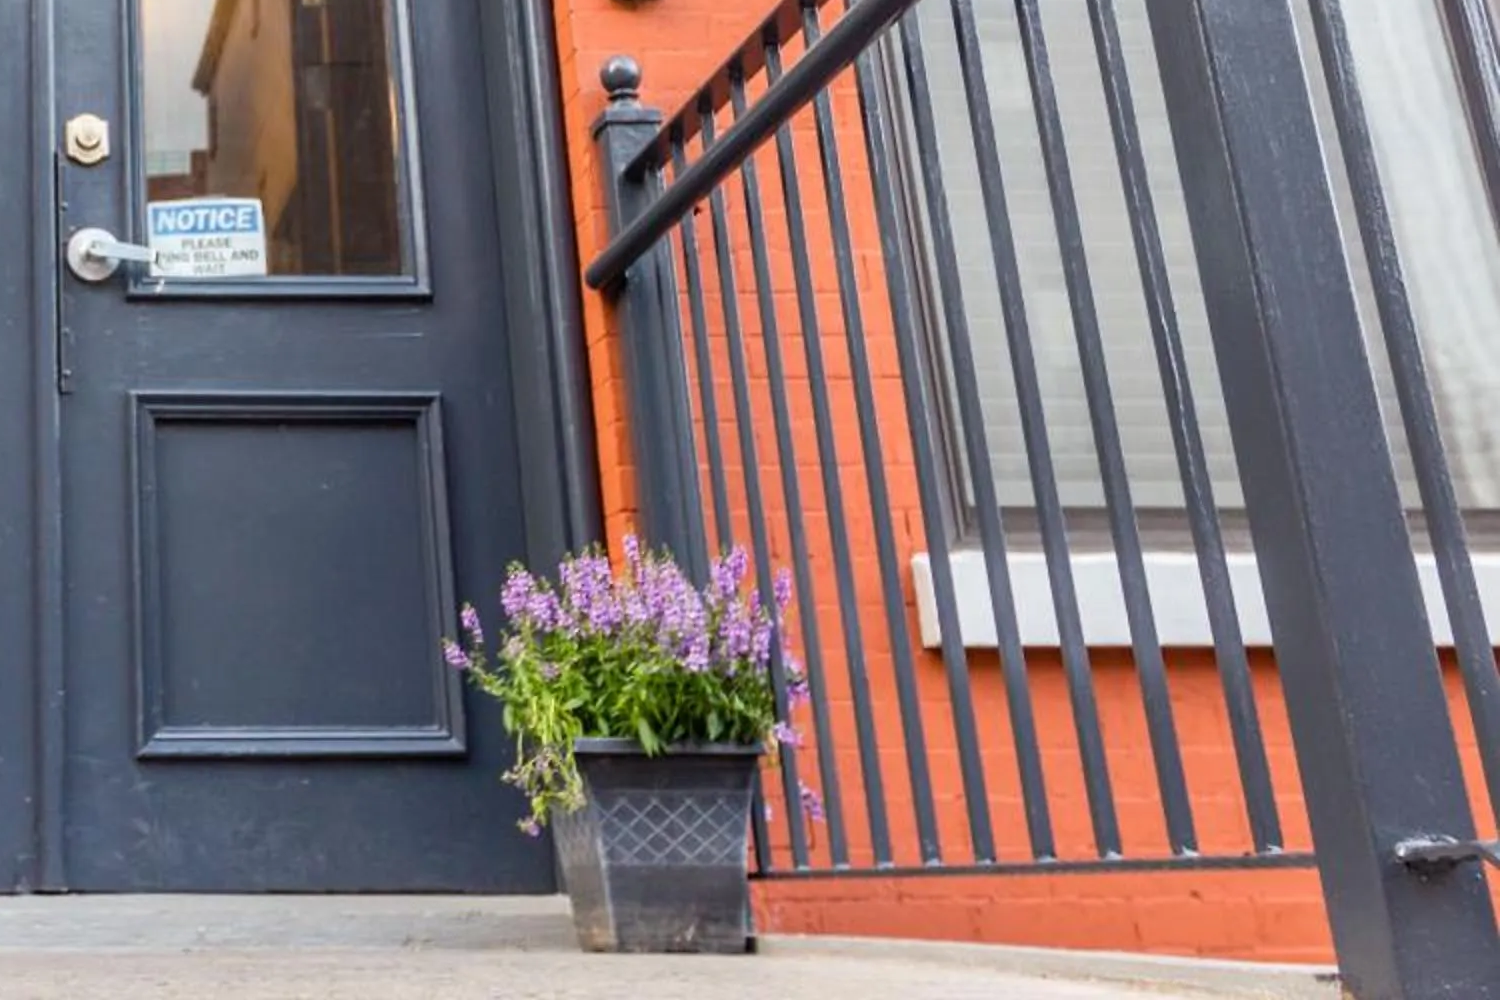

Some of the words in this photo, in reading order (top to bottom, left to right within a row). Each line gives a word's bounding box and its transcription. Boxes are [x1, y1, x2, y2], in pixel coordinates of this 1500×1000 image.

[156, 206, 254, 233] NOTICE
[181, 237, 232, 250] PLEASE
[193, 250, 227, 262] BELL
[231, 249, 260, 262] AND
[193, 263, 226, 274] WAIT
